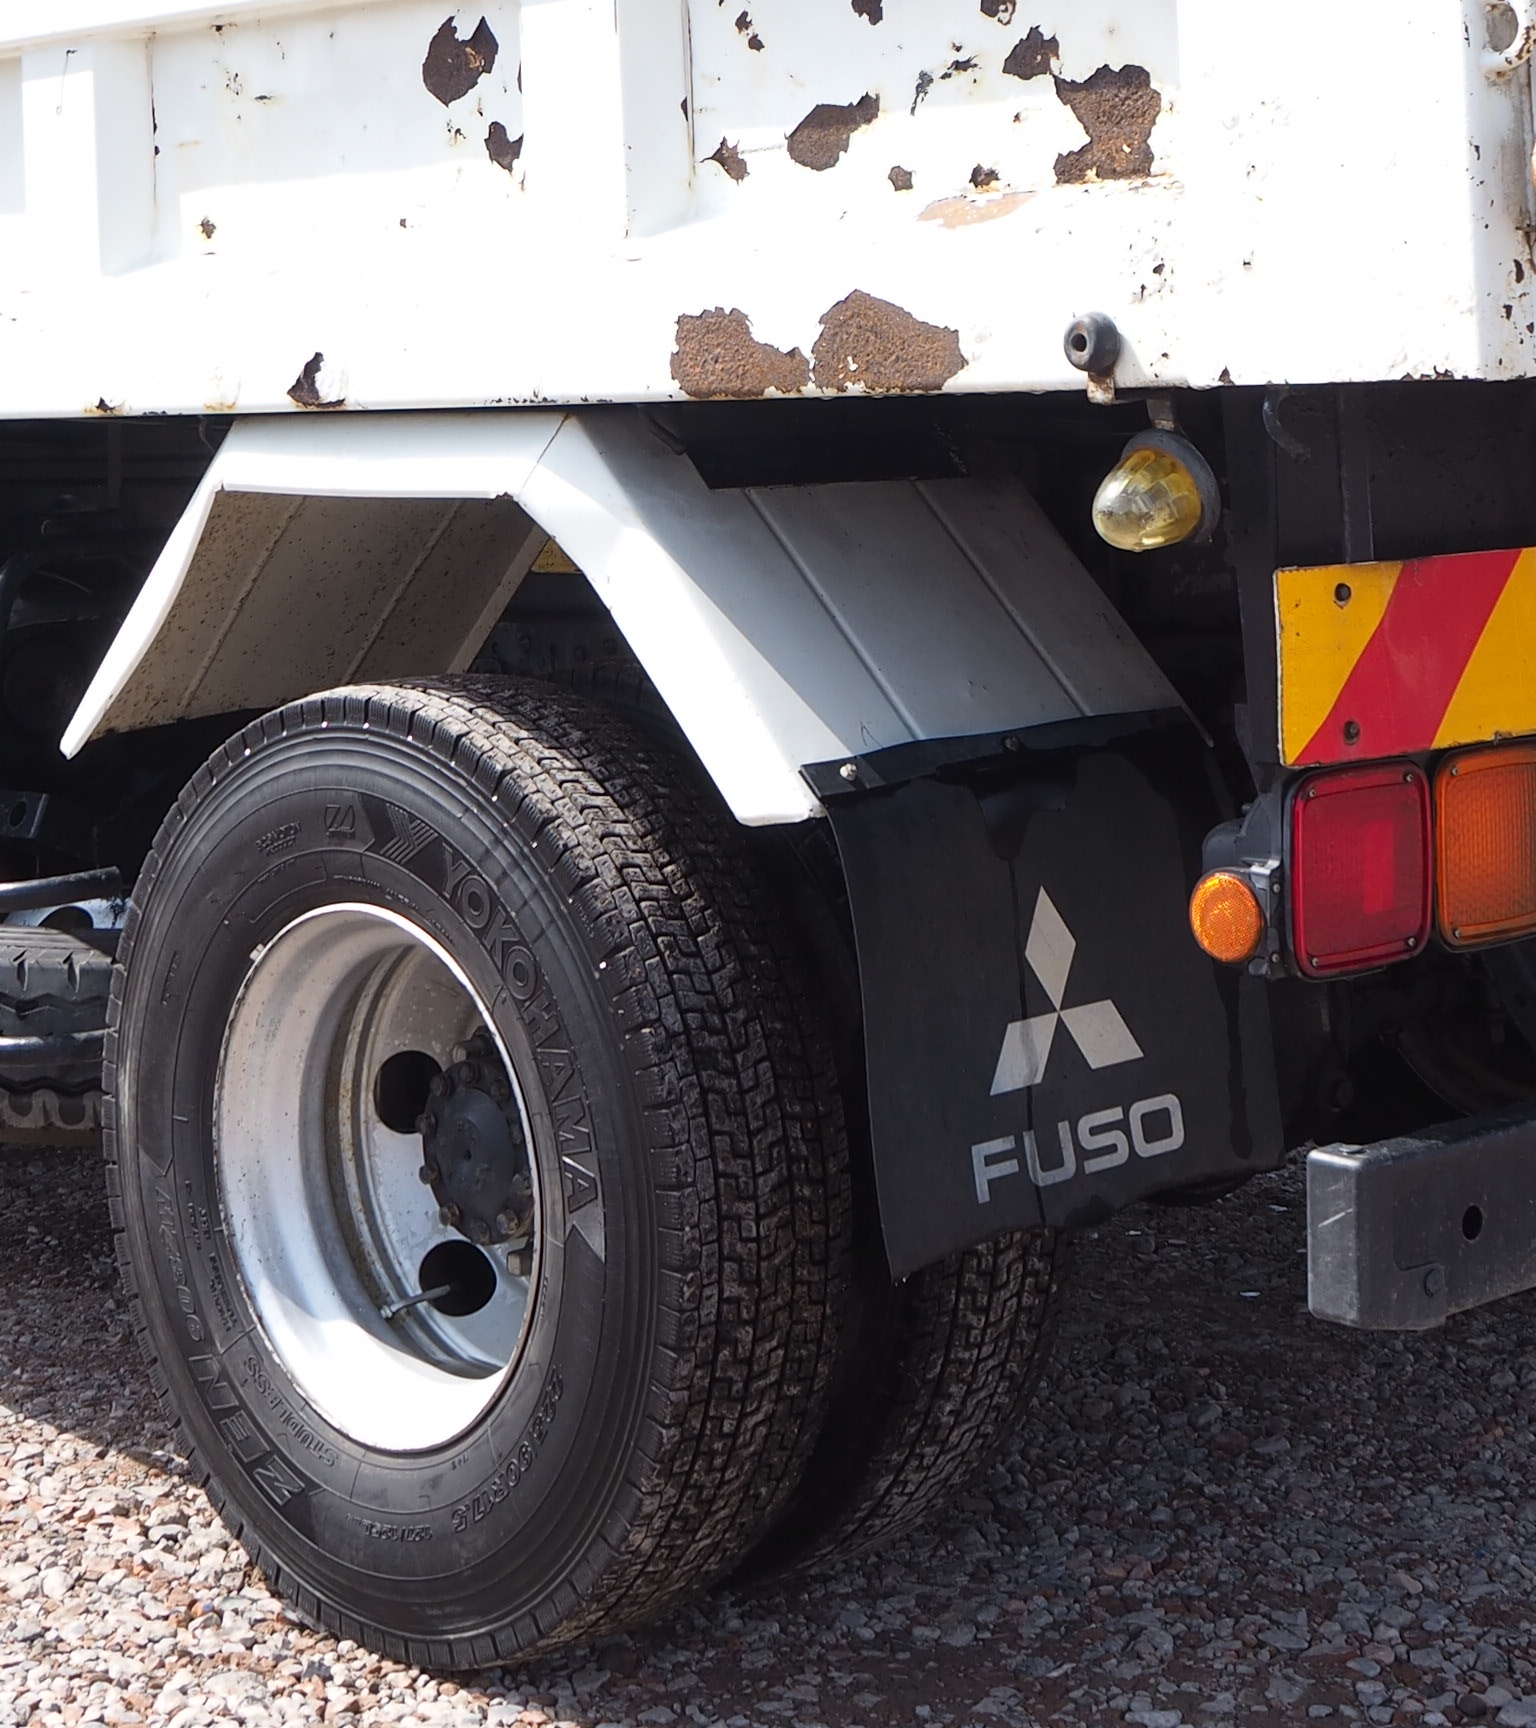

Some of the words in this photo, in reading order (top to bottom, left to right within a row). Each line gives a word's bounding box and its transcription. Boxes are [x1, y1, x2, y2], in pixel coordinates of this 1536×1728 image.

[441, 841, 599, 1215] YOKOHAMA
[971, 1093, 1186, 1204] FUSO
[189, 1353, 306, 1507] ZEN
[243, 1354, 339, 1468] STUDLESS
